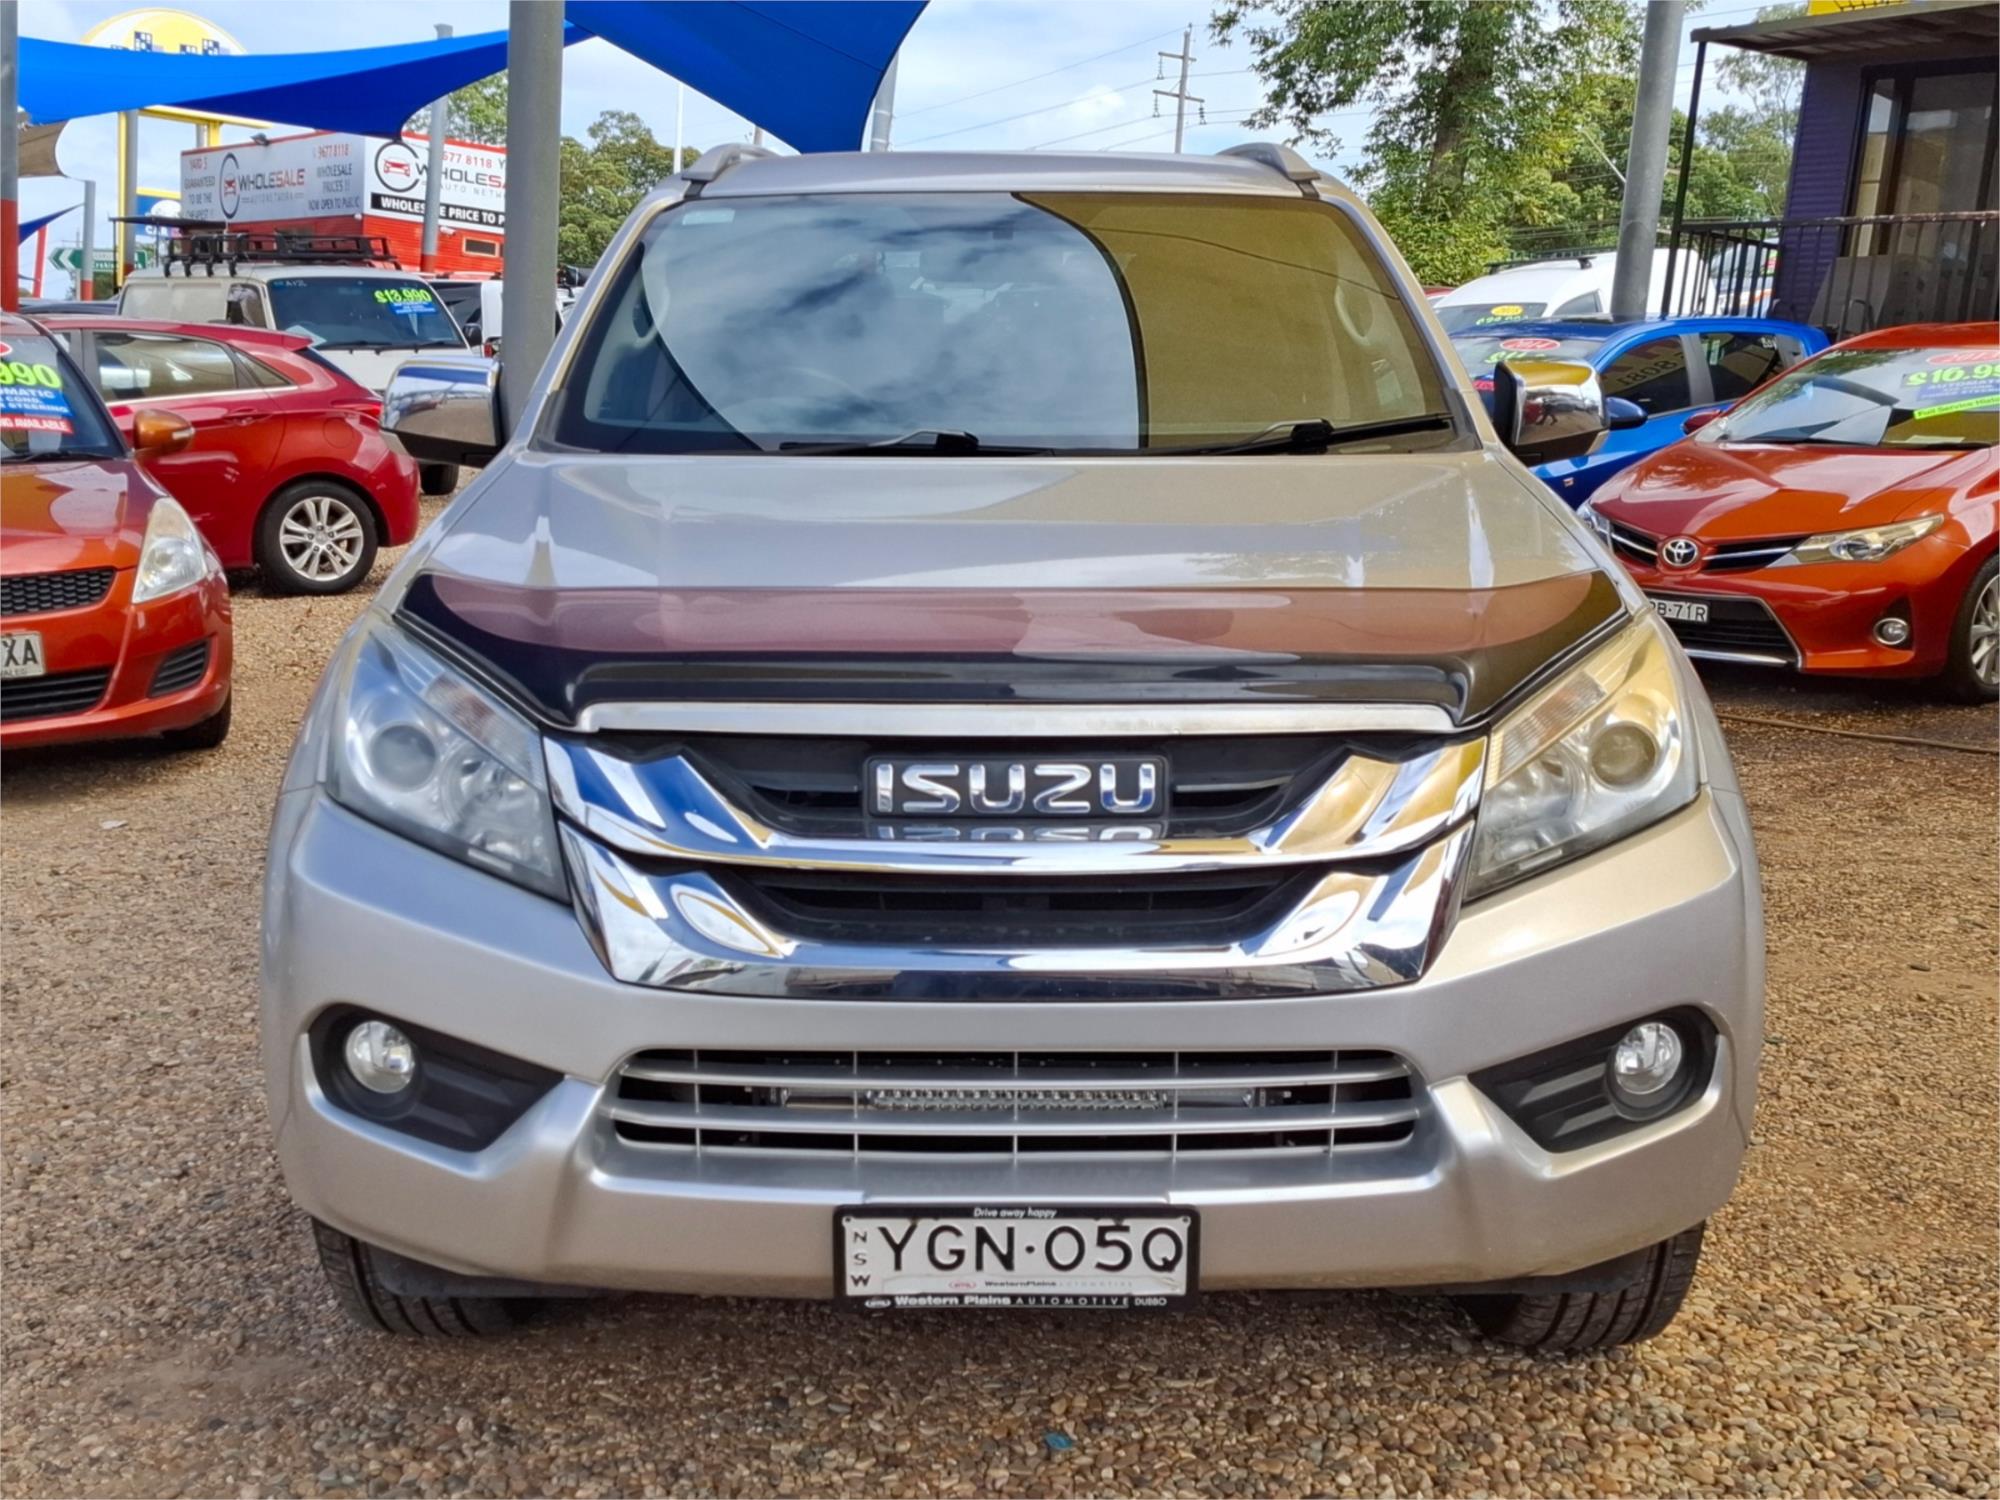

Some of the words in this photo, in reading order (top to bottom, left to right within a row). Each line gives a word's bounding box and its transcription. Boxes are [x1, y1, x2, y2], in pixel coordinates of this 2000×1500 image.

[239, 169, 305, 191] WHOLESALE
[448, 206, 480, 222] PRICE
[481, 211, 496, 224] TO
[876, 763, 1156, 813] ISUZU
[974, 1206, 999, 1218] Drive
[1000, 1208, 1025, 1219] away
[1027, 1206, 1058, 1219] happy
[894, 1295, 960, 1306] Western
[964, 1294, 1012, 1306] Plains
[1015, 1296, 1130, 1307] AUTOMOTIVE
[1134, 1297, 1168, 1307] DUBBO
